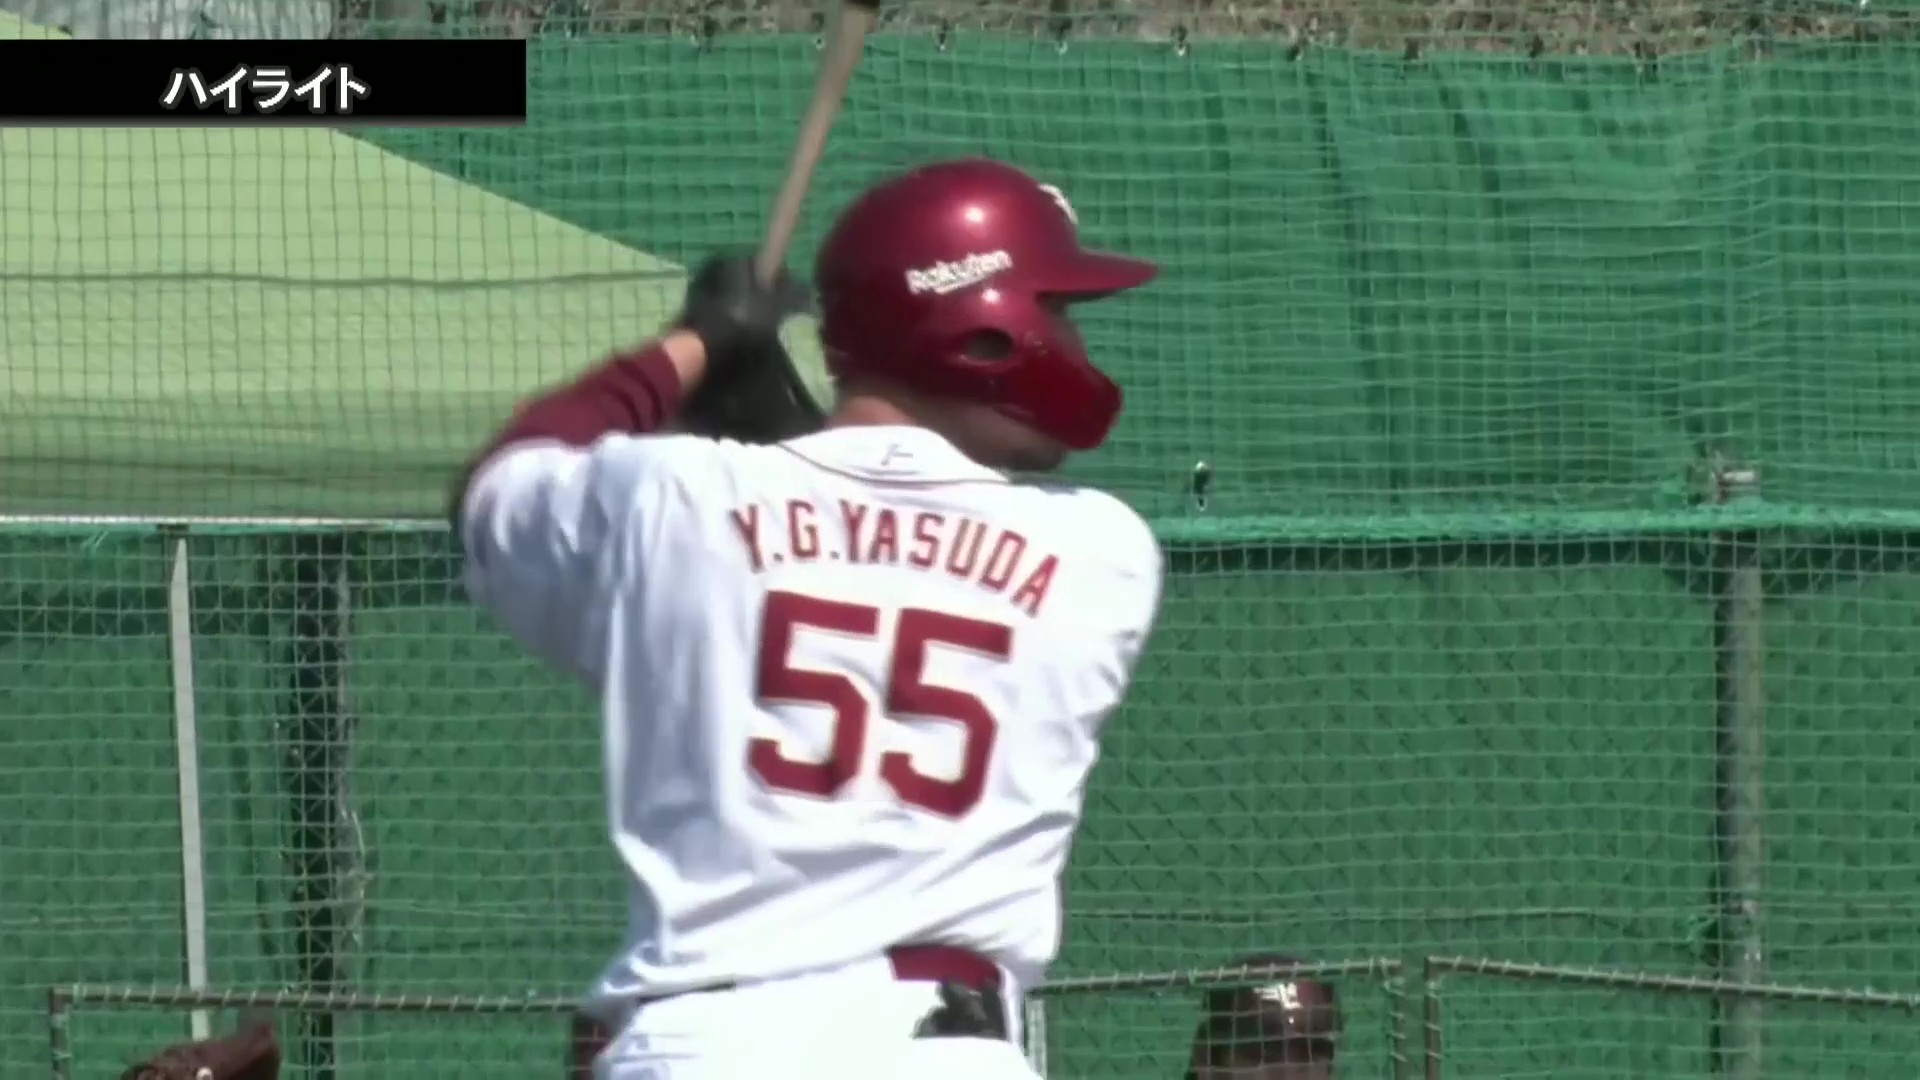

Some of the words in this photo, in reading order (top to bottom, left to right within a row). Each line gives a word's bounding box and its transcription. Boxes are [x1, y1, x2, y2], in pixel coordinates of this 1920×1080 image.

[904, 249, 1013, 295] Rakuten
[729, 497, 1060, 617] Y.G.YASUDA
[745, 589, 1014, 821] 55
